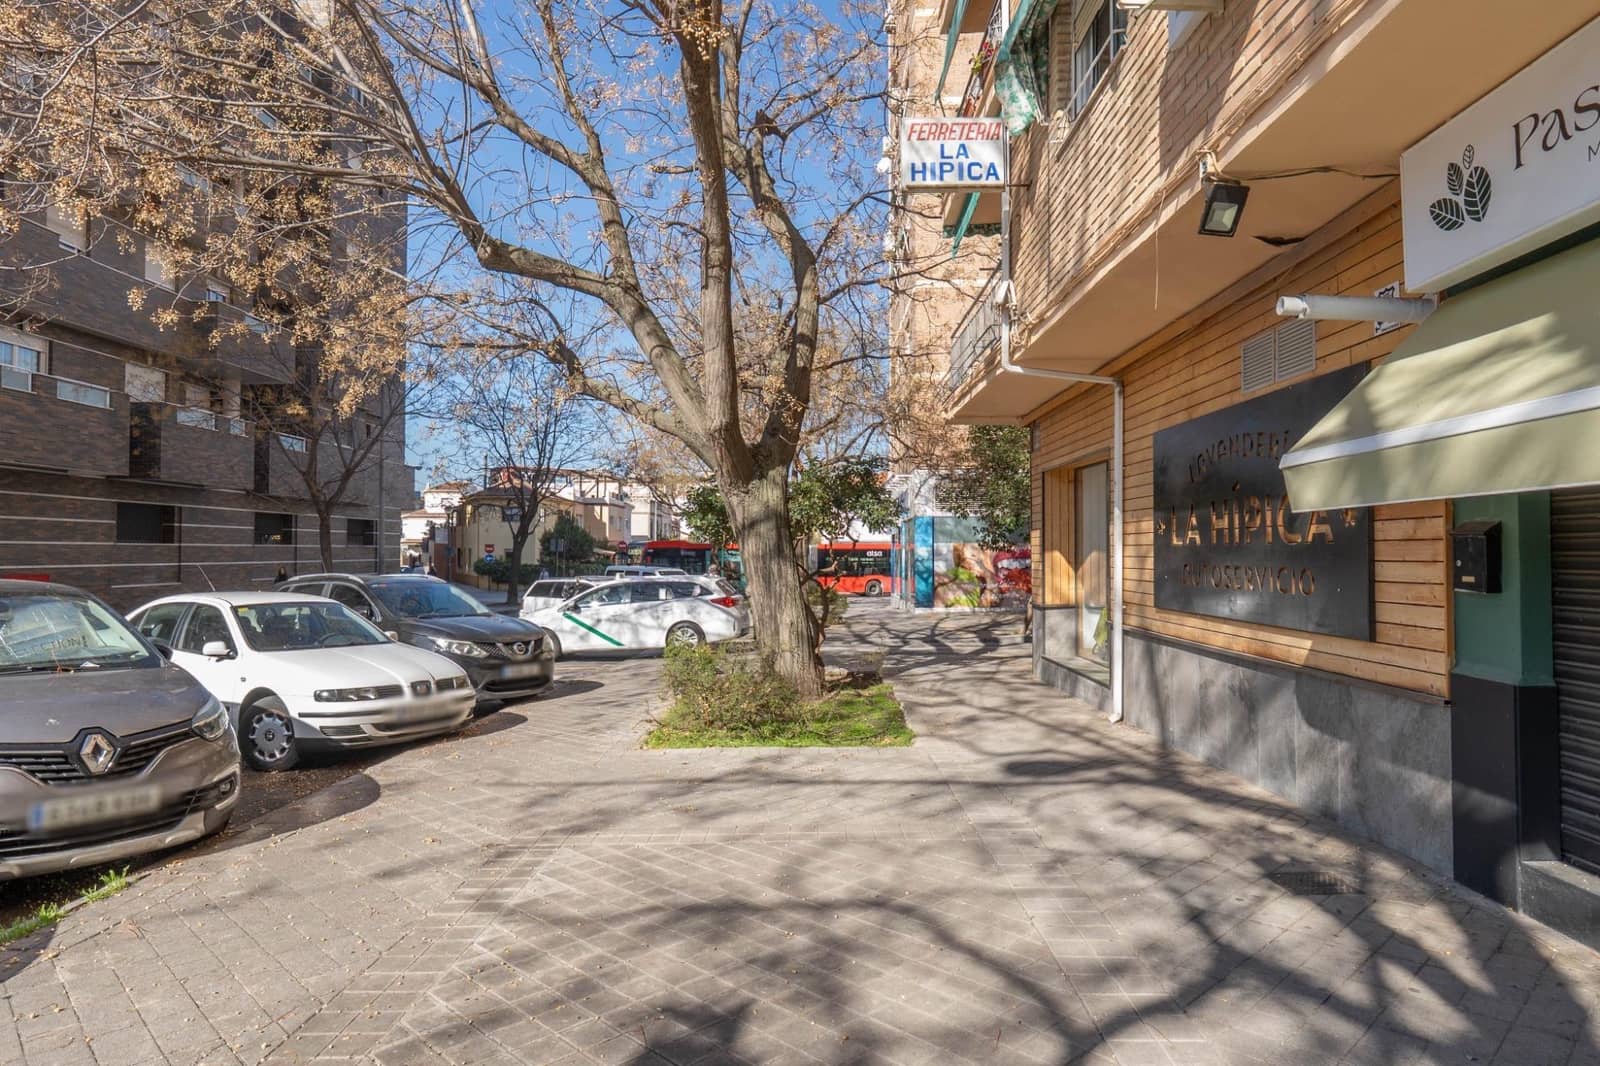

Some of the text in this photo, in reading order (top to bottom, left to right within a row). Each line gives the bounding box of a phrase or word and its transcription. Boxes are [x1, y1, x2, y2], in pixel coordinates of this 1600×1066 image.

[907, 122, 1002, 141] FERRETERIA
[940, 143, 970, 160] LA
[911, 162, 1001, 182] HIPICA
[1169, 504, 1202, 546] LA
